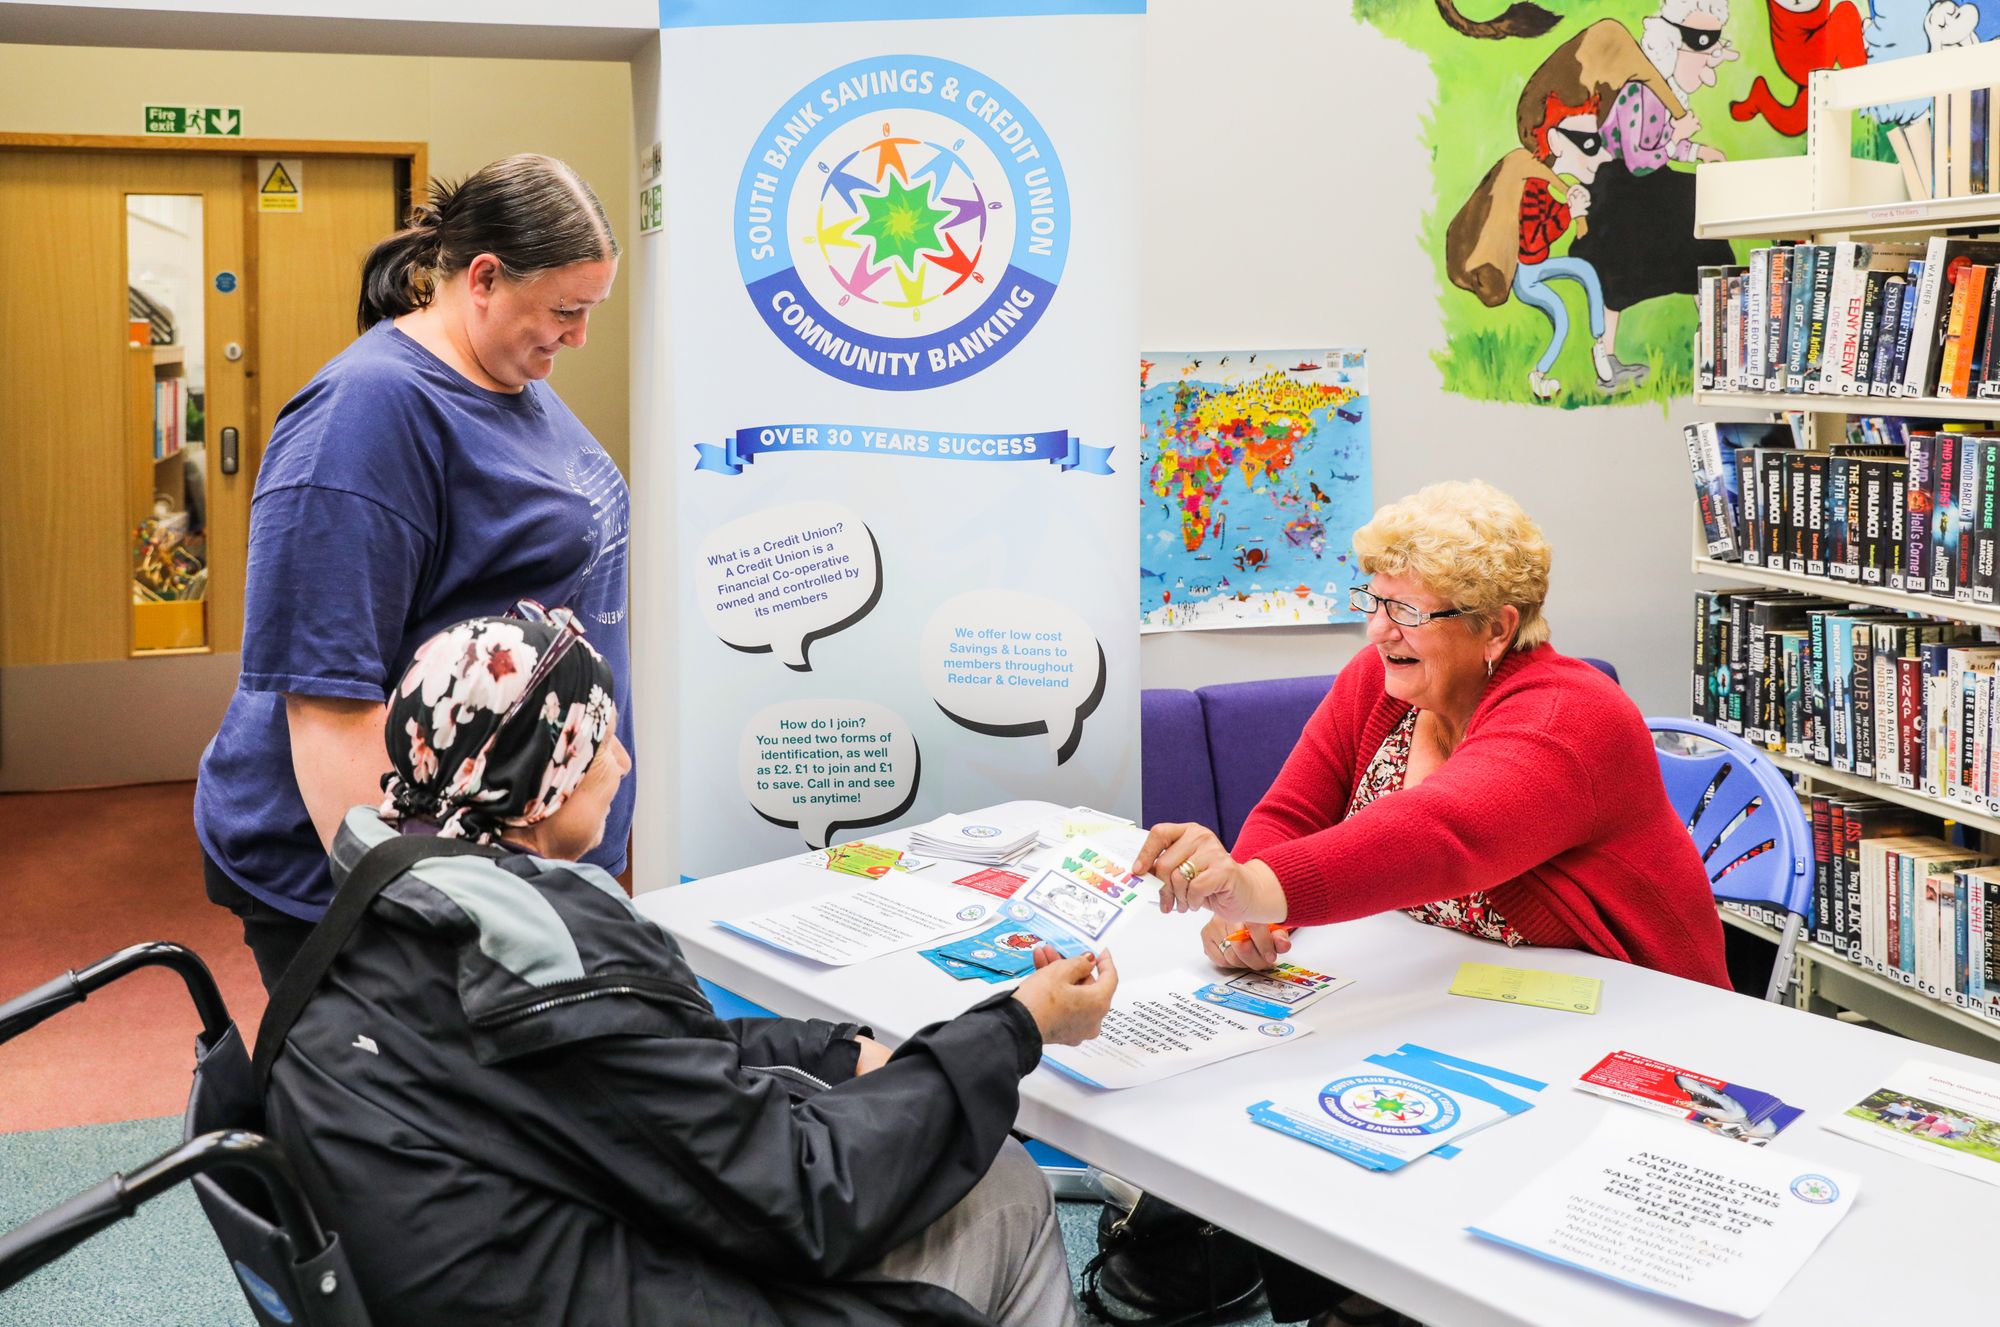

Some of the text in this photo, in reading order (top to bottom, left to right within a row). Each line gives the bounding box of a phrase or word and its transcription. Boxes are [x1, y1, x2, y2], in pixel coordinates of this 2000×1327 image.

[150, 109, 176, 121] Fire
[150, 121, 175, 132] exit
[749, 69, 1055, 261] SOUTH BANK SAVINGS & CREDIT UNION
[1770, 253, 1785, 319] TRUTH DARE
[1812, 250, 1830, 320] ALL FALL DOWN
[771, 284, 1035, 376] COMMUNITY BANKING
[1884, 287, 1898, 331] STOLEN
[1750, 293, 1760, 372] LITTLE BOY BLUE
[1841, 297, 1861, 376] EENY MEENY
[1857, 311, 1874, 378] HIDE SEEK
[1896, 301, 1912, 361] DRIFTNET
[760, 428, 1037, 456] OVER 30 YEARS SUCCESS
[1834, 475, 1847, 499] FIFTH
[1940, 439, 1953, 508] FIND YOU FIRST
[1961, 444, 1974, 519] LINWOOD BARCLAY
[1984, 447, 1996, 529] NO SAFE HOUSE
[1743, 471, 1755, 520] BALDACCI
[1769, 474, 1780, 524] BALDACCI
[1793, 477, 1804, 527] BALDACCI
[1810, 478, 1821, 530] BALDACCI
[1867, 485, 1879, 538] BALDACCI
[1892, 486, 1903, 540] BALDACCI
[707, 551, 737, 566] What
[740, 549, 750, 558] is
[763, 535, 800, 552] Credit
[802, 523, 843, 542] Union?
[726, 543, 833, 577] A Credit Union is a
[1909, 513, 1924, 576] Hell's Corner
[716, 568, 859, 611] owned and controlled by
[718, 554, 849, 595] Financial Co-operative
[755, 592, 828, 617] its members
[950, 643, 1067, 657] Savings & Loans to
[955, 628, 1062, 641] We offer low cost
[1812, 615, 1822, 660] ELEVATOR
[944, 659, 1073, 673] members throughout
[948, 673, 1069, 688] Redcar & Cleveland
[1853, 652, 1868, 711] BAUER
[1886, 669, 1895, 754] BELINDA BAUER
[1902, 676, 1911, 718] SNAP
[756, 733, 892, 745] You need two forms of
[780, 718, 866, 730] How do I join?
[1878, 709, 1887, 760] KEEPERS
[757, 763, 892, 775] as £2. £1 to join and £1
[762, 748, 888, 760] identification, as well
[757, 781, 768, 790] to
[807, 779, 830, 788] Call
[834, 779, 844, 788] in
[848, 778, 870, 788] and
[793, 793, 861, 805] us anytime!
[1079, 848, 1143, 888] HOW IT
[1848, 891, 1859, 933] BLACK
[1985, 930, 1993, 958] BLACK
[1985, 959, 1994, 980] LIES
[1133, 1001, 1212, 1041] CAUGHT OUT THIS
[1133, 1011, 1187, 1038] CHRISTMAS!
[1148, 1001, 1218, 1035] AVOID GETTING
[1169, 992, 1248, 1032] CALL OUT TO NEW
[1173, 1003, 1220, 1026] MEMBERS!
[1147, 1027, 1193, 1052] PER WEEK
[1366, 1124, 1421, 1134] BANKING
[1627, 1157, 1780, 1208] LOAN SHARKS THIS
[1638, 1151, 1781, 1199] AVOID THE LOCAL
[1646, 1172, 1745, 1206] CHRISTMAS!
[1603, 1168, 1643, 1184] SAVE
[1690, 1197, 1721, 1210] PER
[1727, 1208, 1775, 1227] WEEK
[1604, 1187, 1671, 1212] RECEIVE
[1610, 1179, 1752, 1228] FOR 13 WEEKS TO
[1636, 1207, 1692, 1228] BONUS
